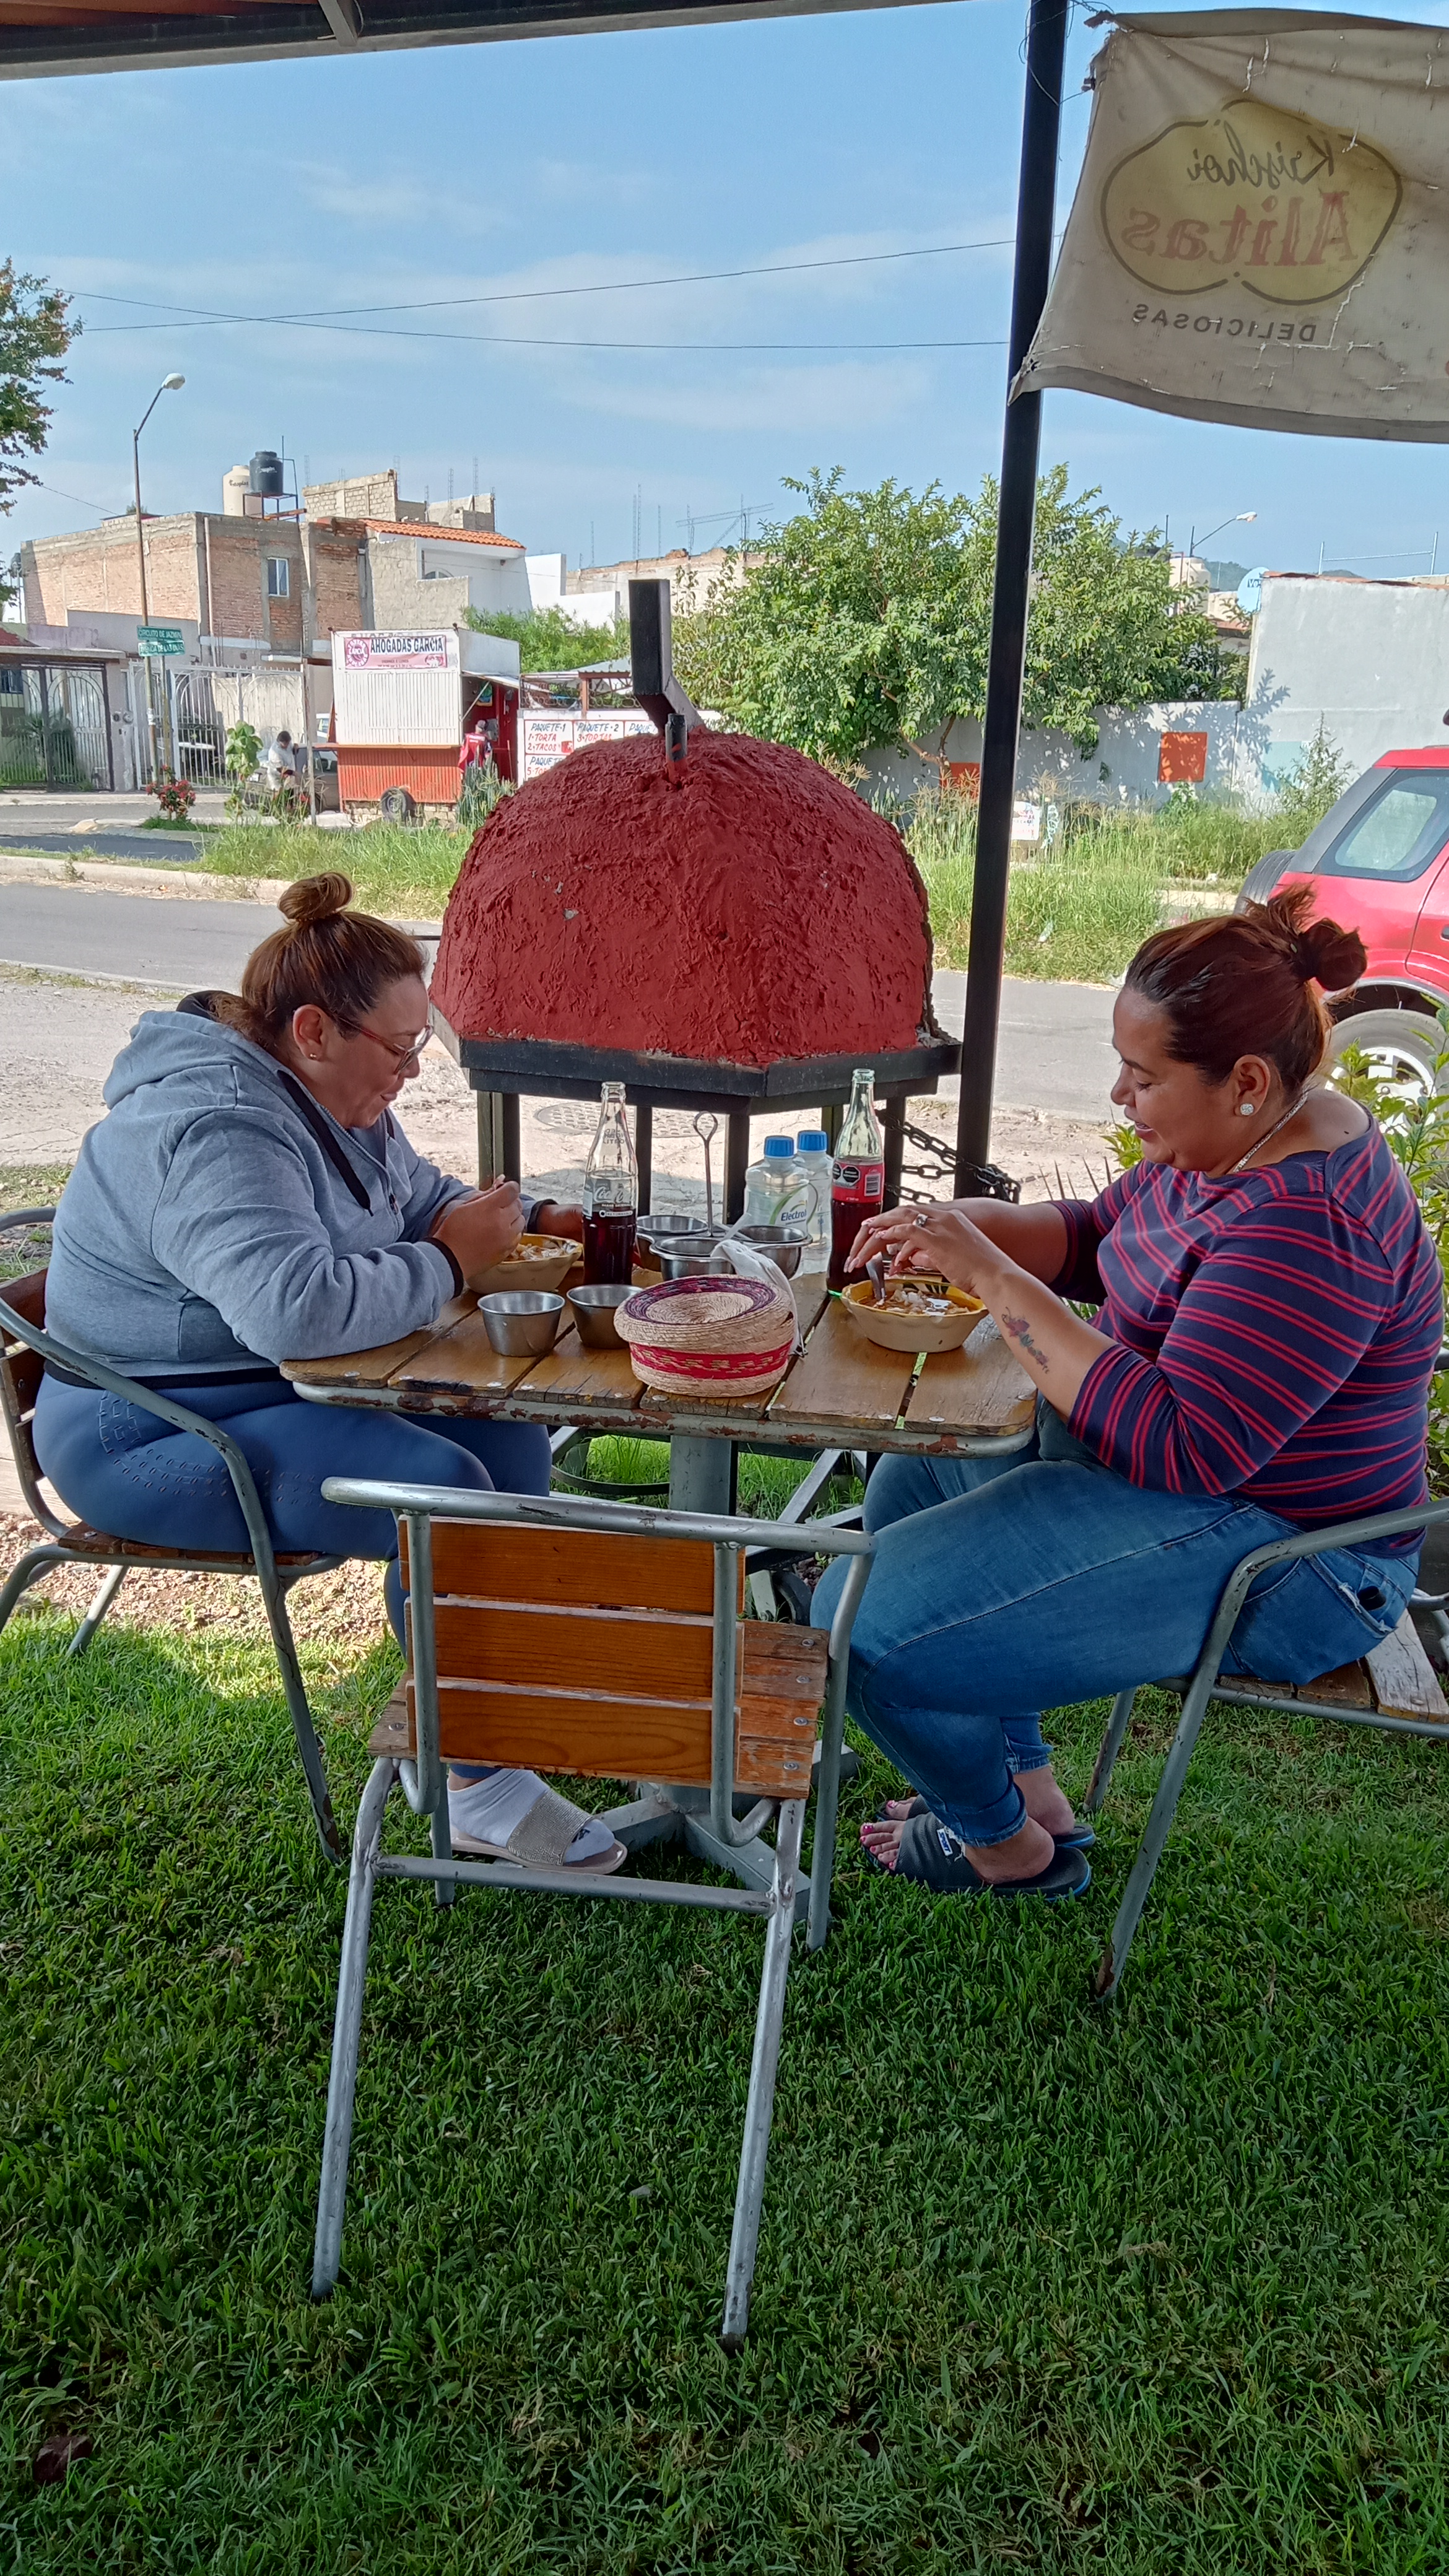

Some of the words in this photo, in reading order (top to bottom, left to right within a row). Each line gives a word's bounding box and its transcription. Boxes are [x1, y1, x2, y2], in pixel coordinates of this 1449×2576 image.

[159, 630, 165, 638] DE
[371, 638, 412, 653] AHOGADAS
[414, 637, 443, 652] GARCIA
[781, 1209, 807, 1221] Electrol
